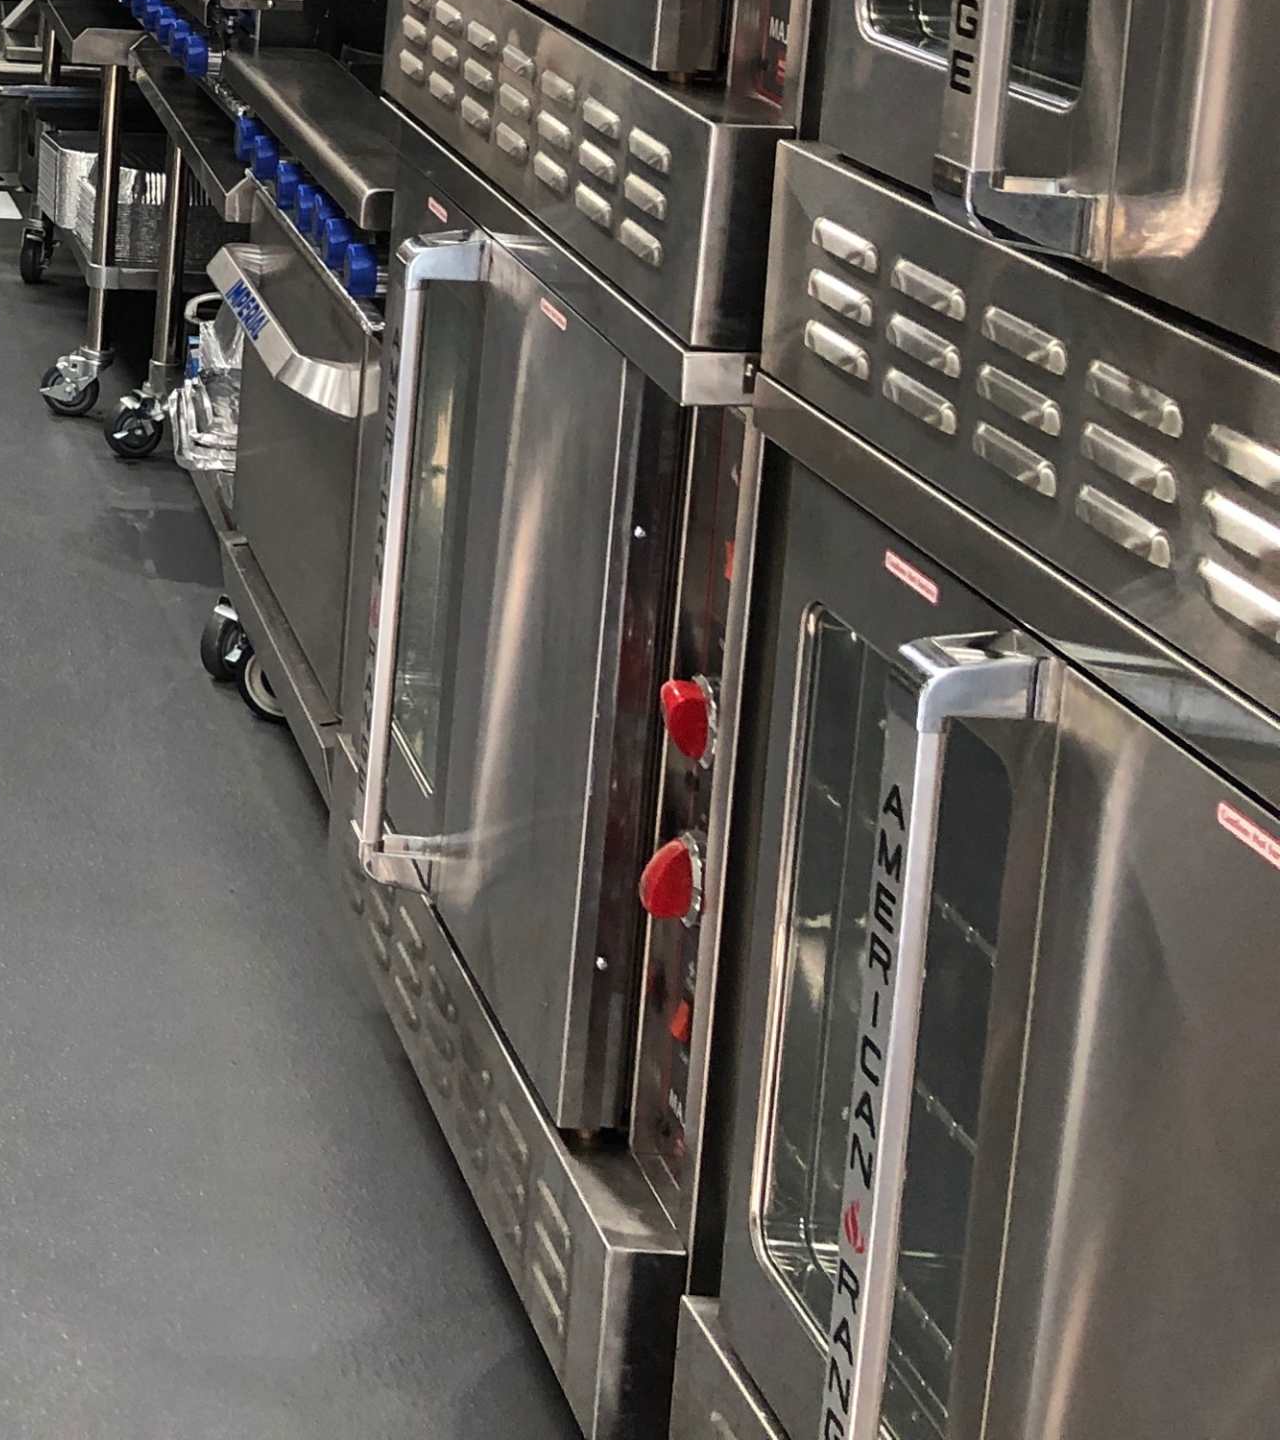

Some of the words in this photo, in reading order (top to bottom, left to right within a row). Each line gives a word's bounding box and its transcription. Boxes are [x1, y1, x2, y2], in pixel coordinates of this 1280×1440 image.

[225, 279, 269, 340] IMPERIAL
[850, 784, 906, 1190] AMERICAN
[825, 1258, 861, 1440] RANG
